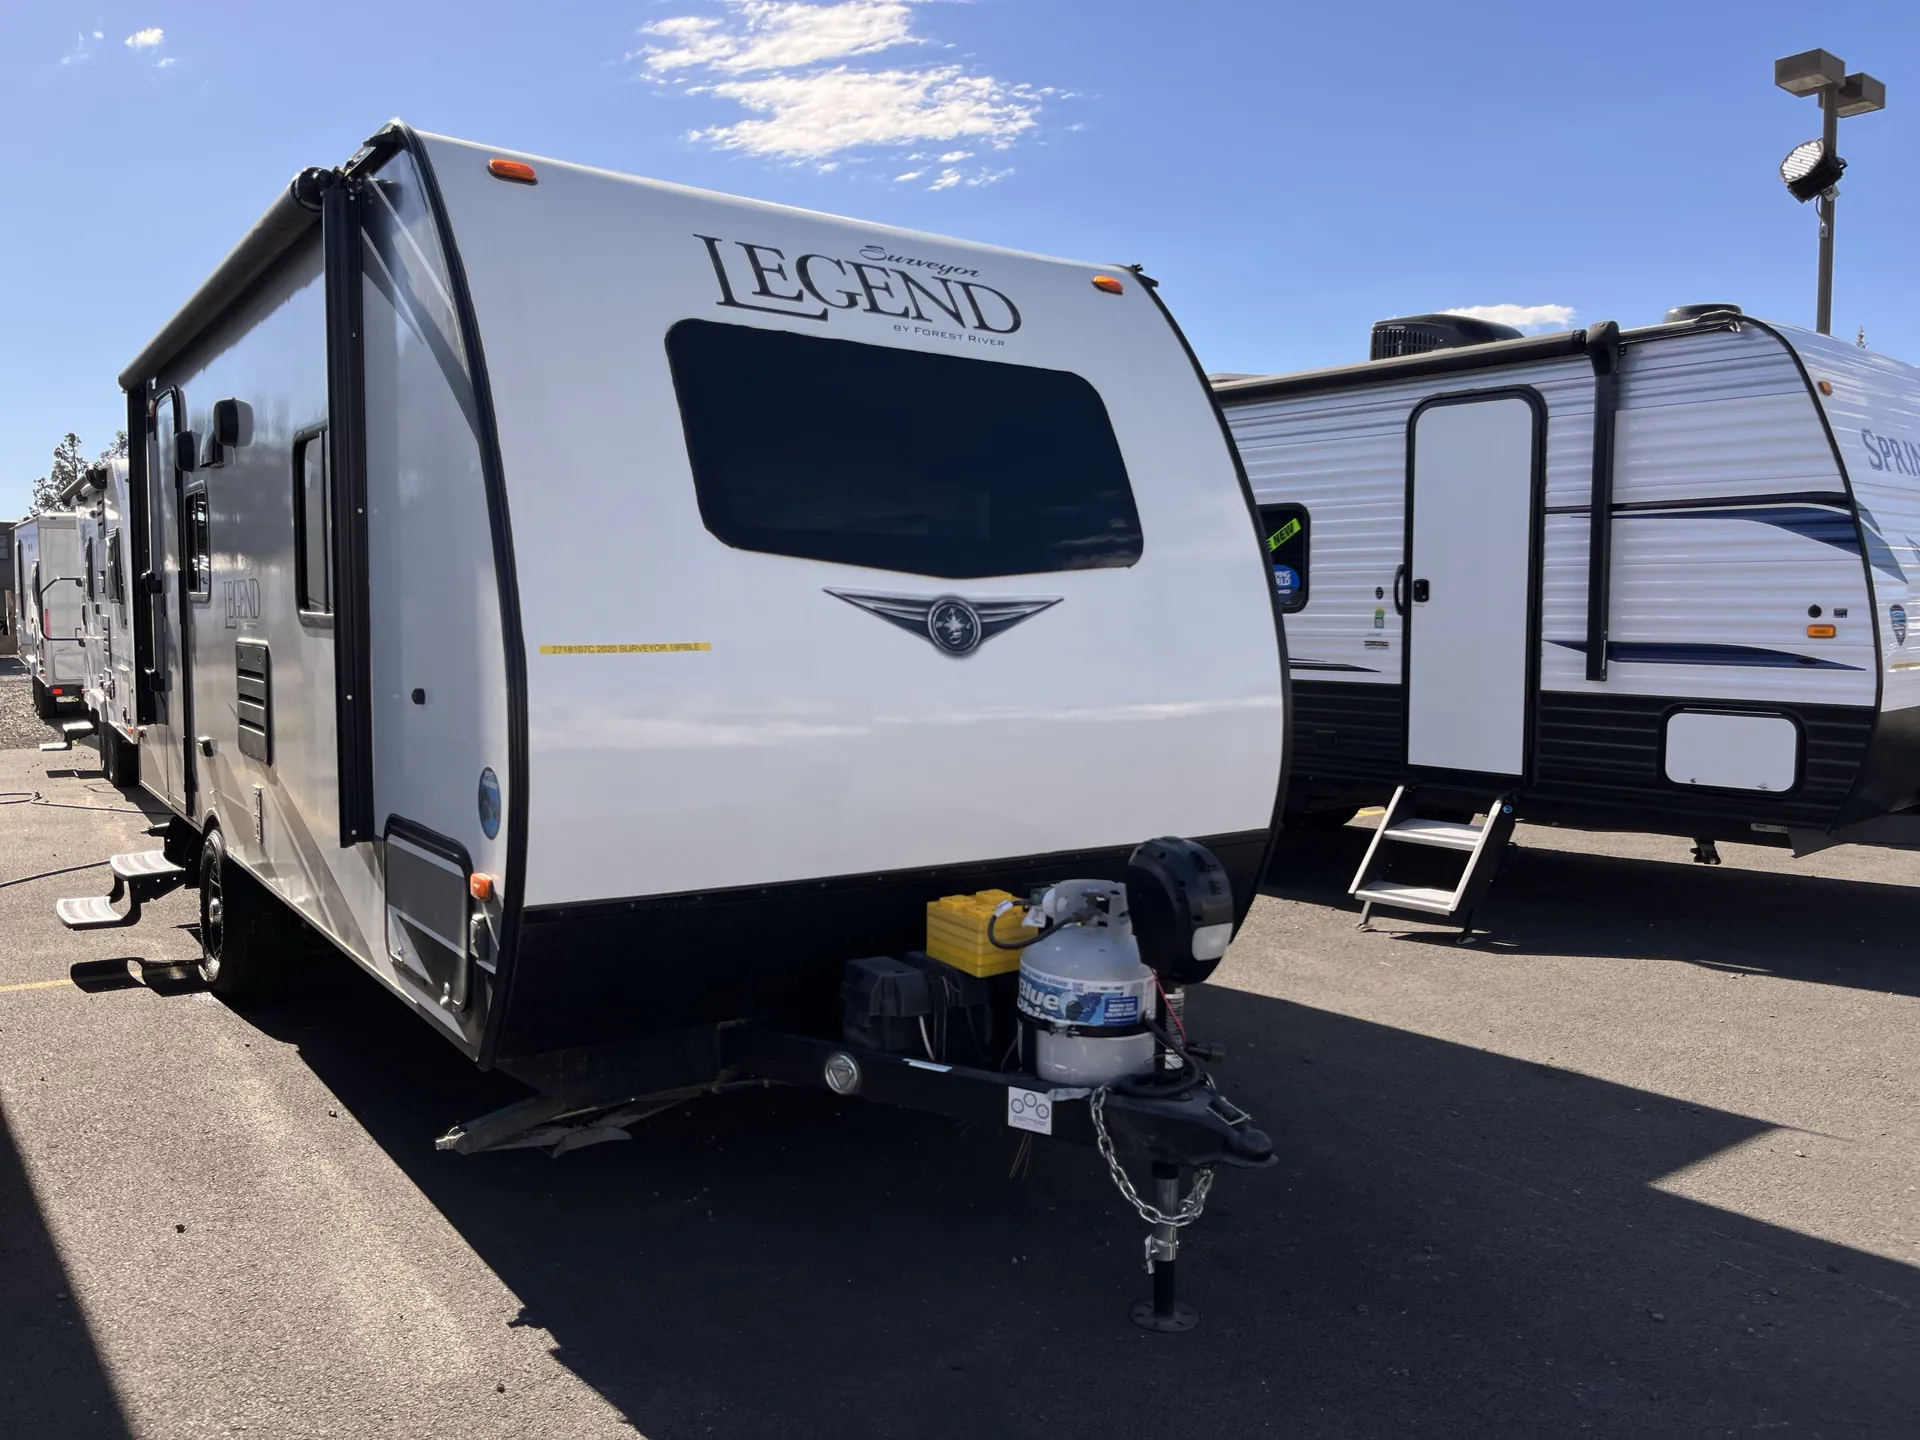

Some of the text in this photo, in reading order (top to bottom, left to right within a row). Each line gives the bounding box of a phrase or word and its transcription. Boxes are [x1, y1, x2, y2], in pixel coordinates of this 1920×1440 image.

[859, 245, 980, 277] Surveyor
[693, 233, 1022, 334] LEGEND
[893, 324, 1005, 347] BY FOREST RIVER
[1273, 522, 1294, 545] NEW
[223, 577, 261, 630] LEGEND
[597, 645, 617, 653] 2020
[619, 643, 667, 653] SURVEYOR
[1019, 977, 1060, 1011] Blue
